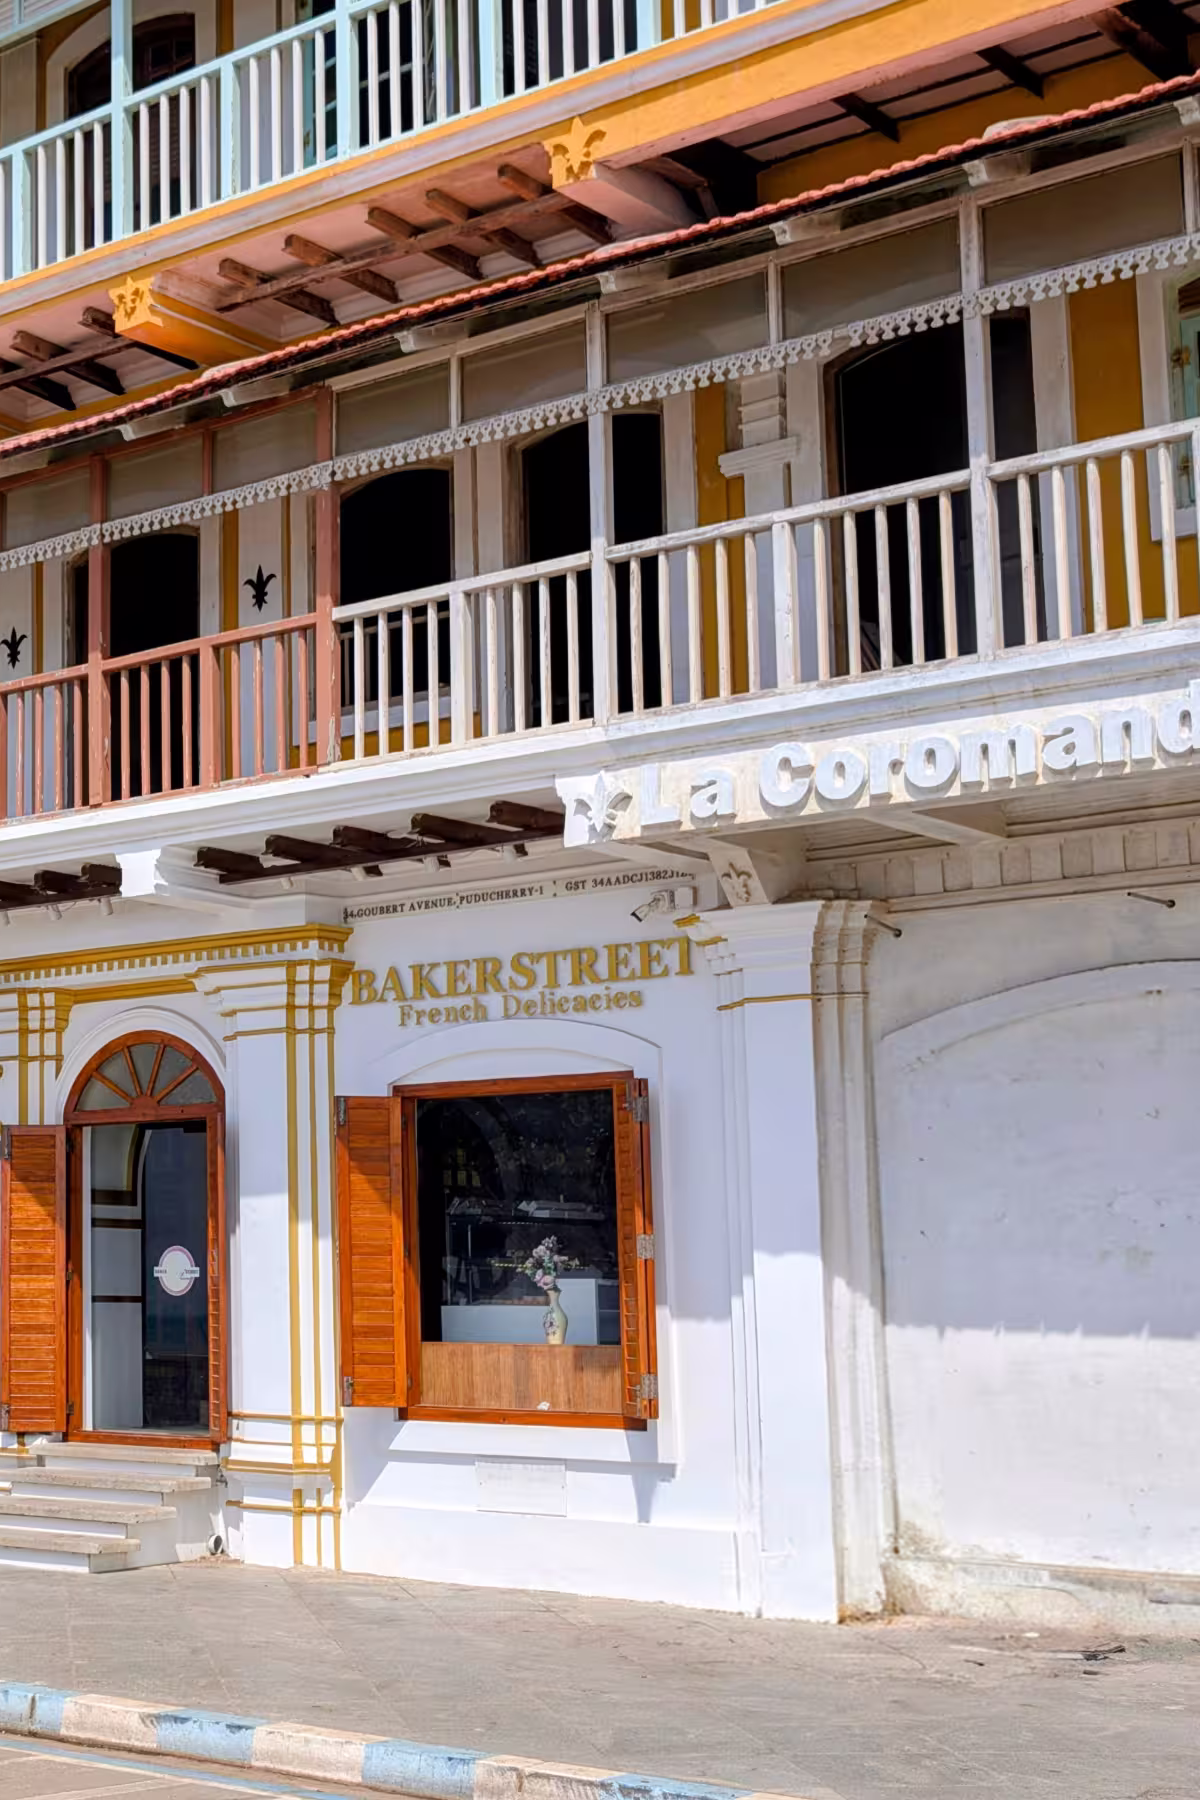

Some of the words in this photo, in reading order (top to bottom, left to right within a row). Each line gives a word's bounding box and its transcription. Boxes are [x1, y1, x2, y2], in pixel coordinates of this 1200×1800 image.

[640, 763, 734, 829] La
[459, 886, 544, 905] PUDUCHERRY-1
[565, 879, 587, 892] GST
[349, 936, 696, 1005] BAKERSTREET
[398, 995, 488, 1028] French
[502, 985, 643, 1019] Delicacies
